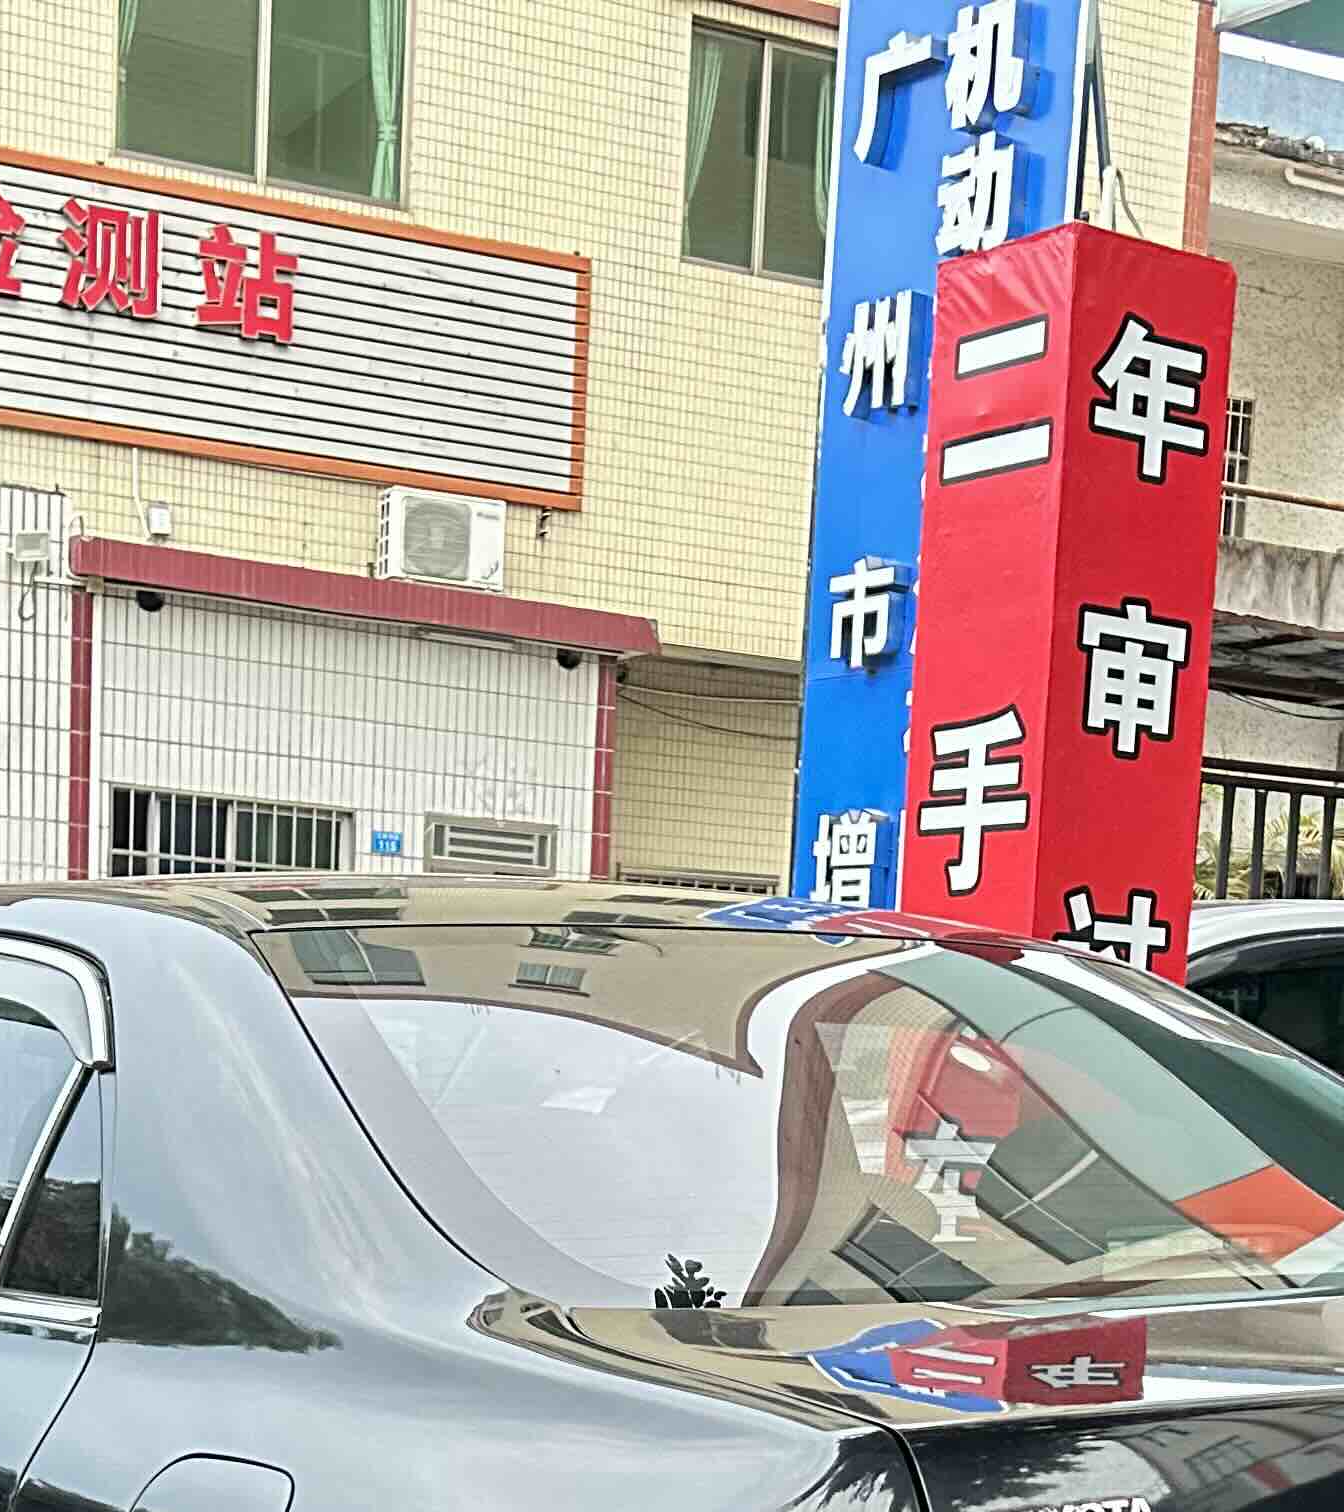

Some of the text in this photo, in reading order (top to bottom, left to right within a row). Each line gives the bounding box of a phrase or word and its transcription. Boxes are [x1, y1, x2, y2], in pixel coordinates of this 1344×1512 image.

[935, 0, 1024, 256] 机动
[810, 30, 933, 908] 广州市增
[919, 314, 1051, 894] 二手
